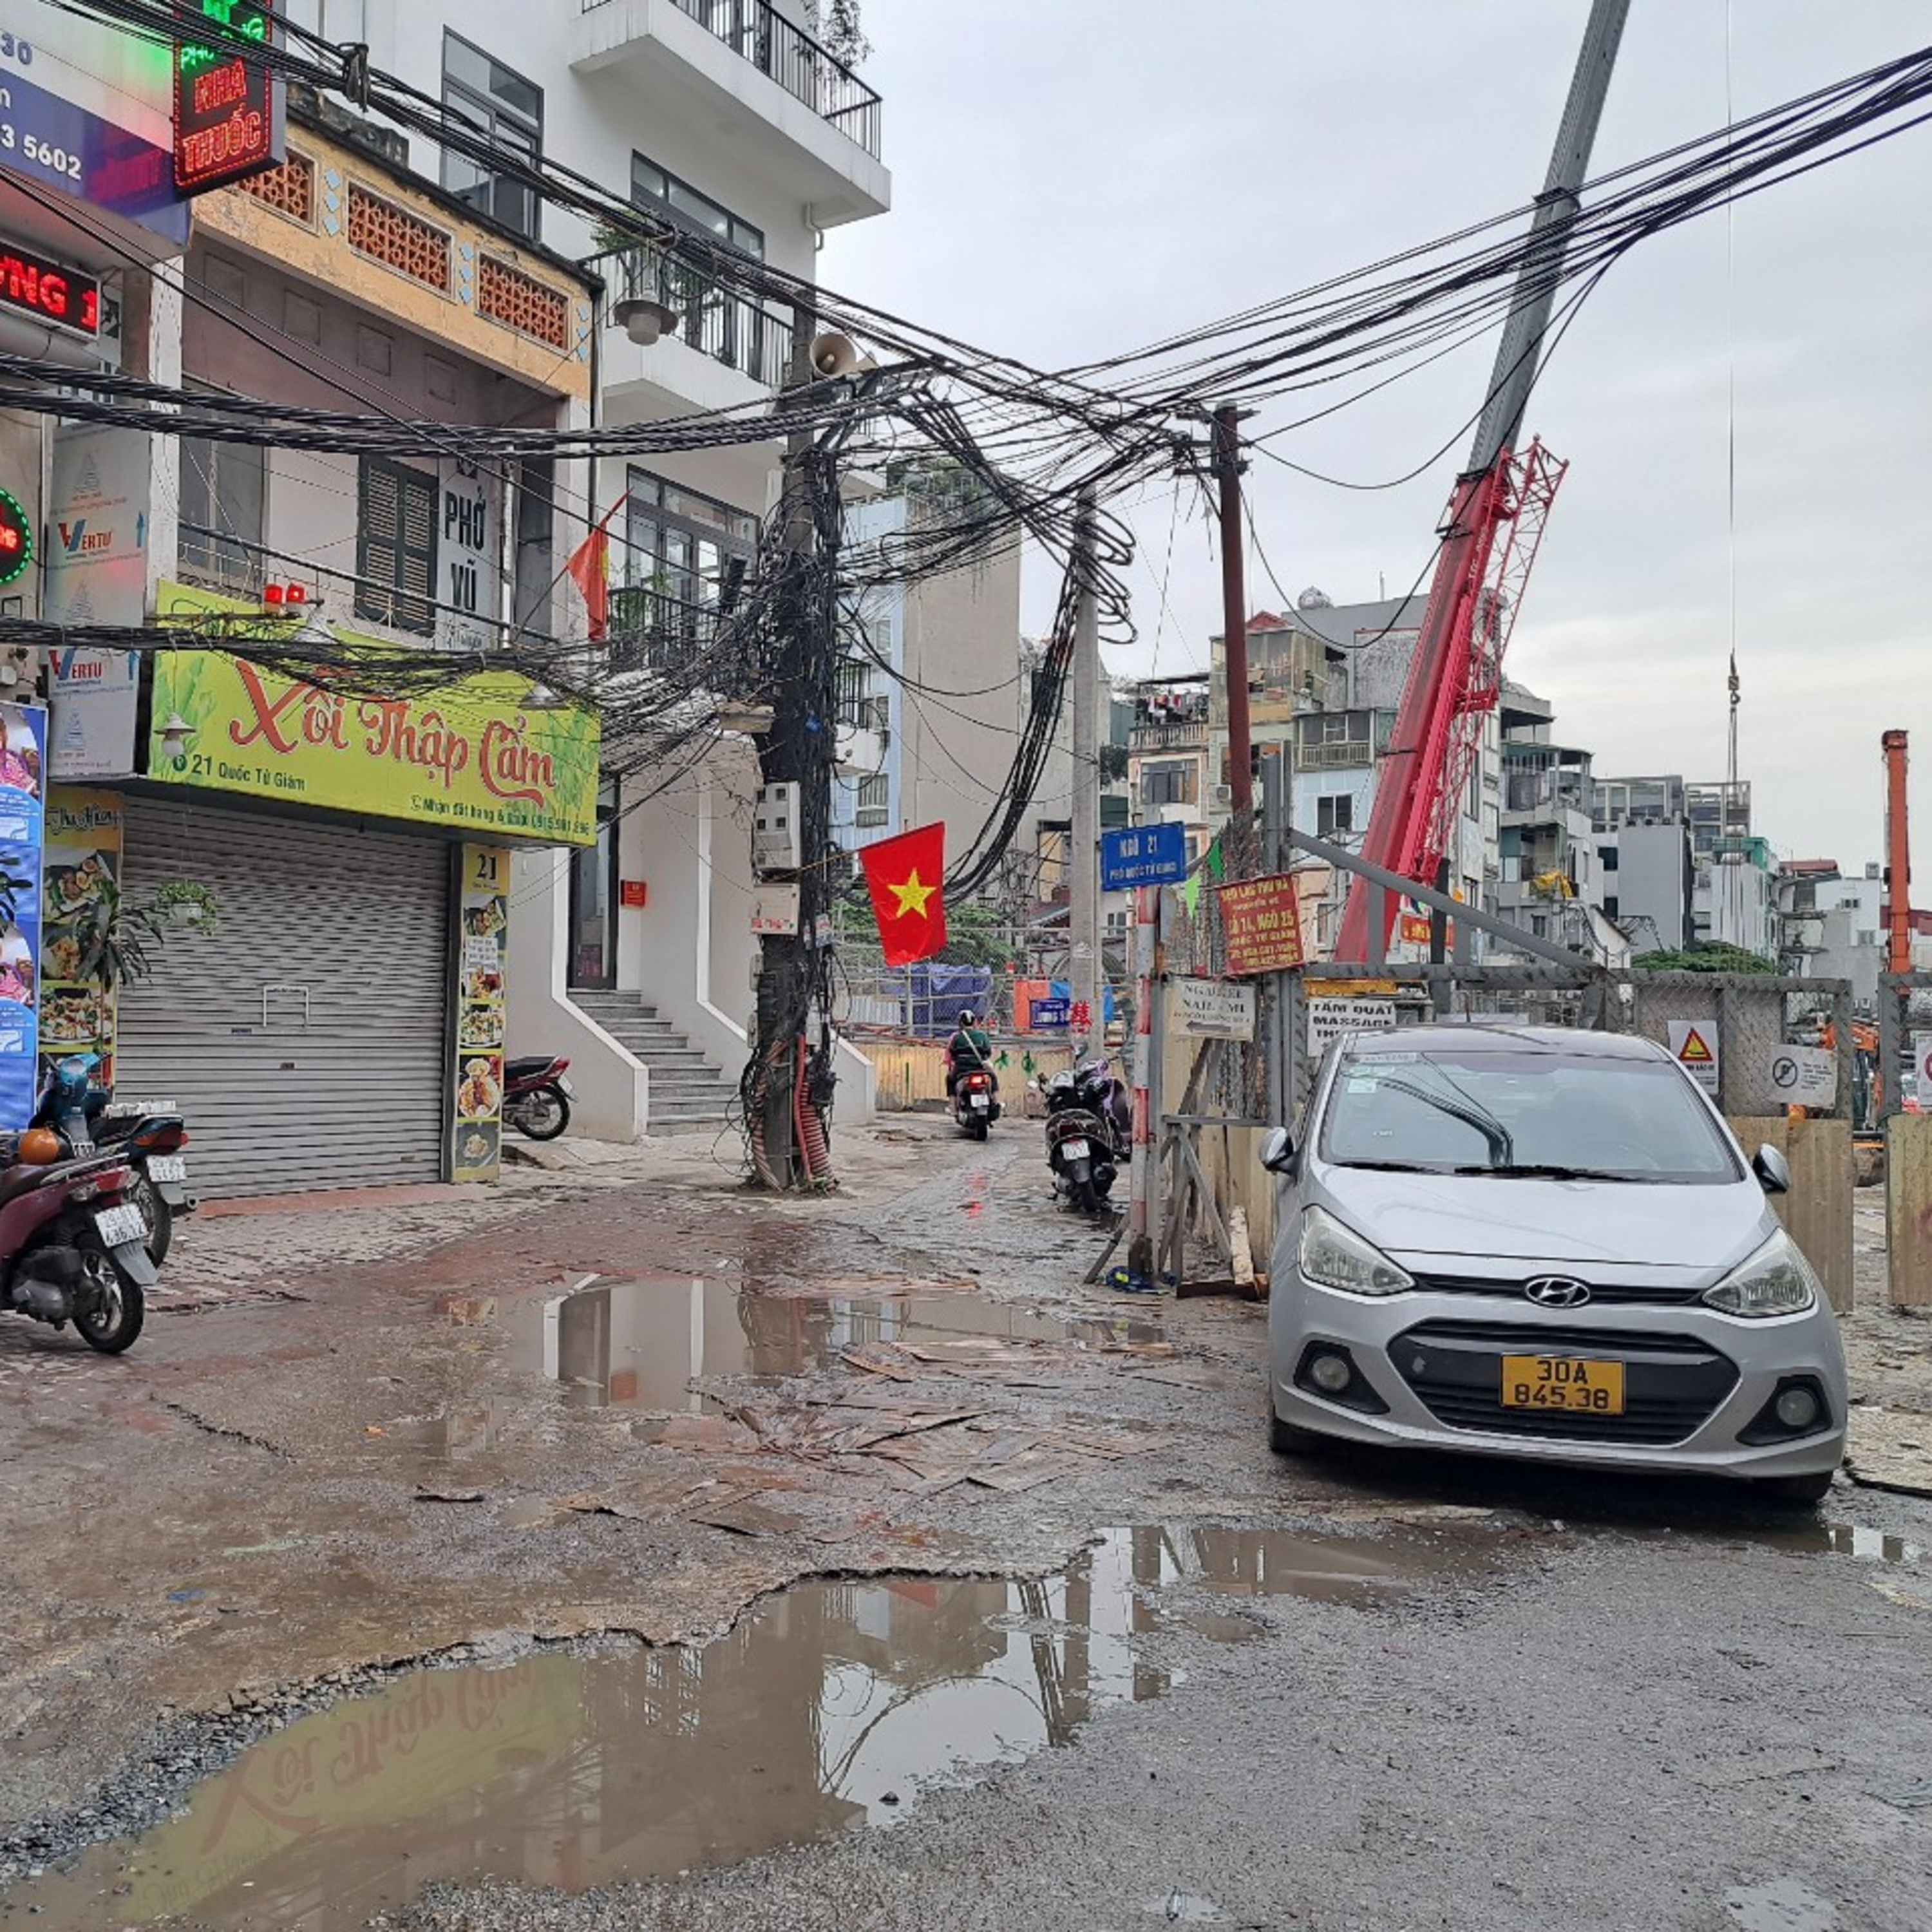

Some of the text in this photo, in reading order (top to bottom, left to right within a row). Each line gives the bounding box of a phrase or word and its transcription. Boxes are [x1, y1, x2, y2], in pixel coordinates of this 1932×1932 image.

[23, 132, 82, 179] 5602
[182, 103, 261, 173] THUỐC
[59, 519, 111, 552] VERTU
[445, 486, 486, 550] PHỞ
[48, 646, 101, 681] VERTU
[230, 659, 556, 808] Xôi Thập Cẩm
[192, 754, 305, 791] 21 Quốc Tử Giám
[1148, 835, 1157, 854] 21
[477, 853, 496, 880] 21
[1537, 1359, 1588, 1384] 30A
[1515, 1384, 1609, 1409] 845.38
